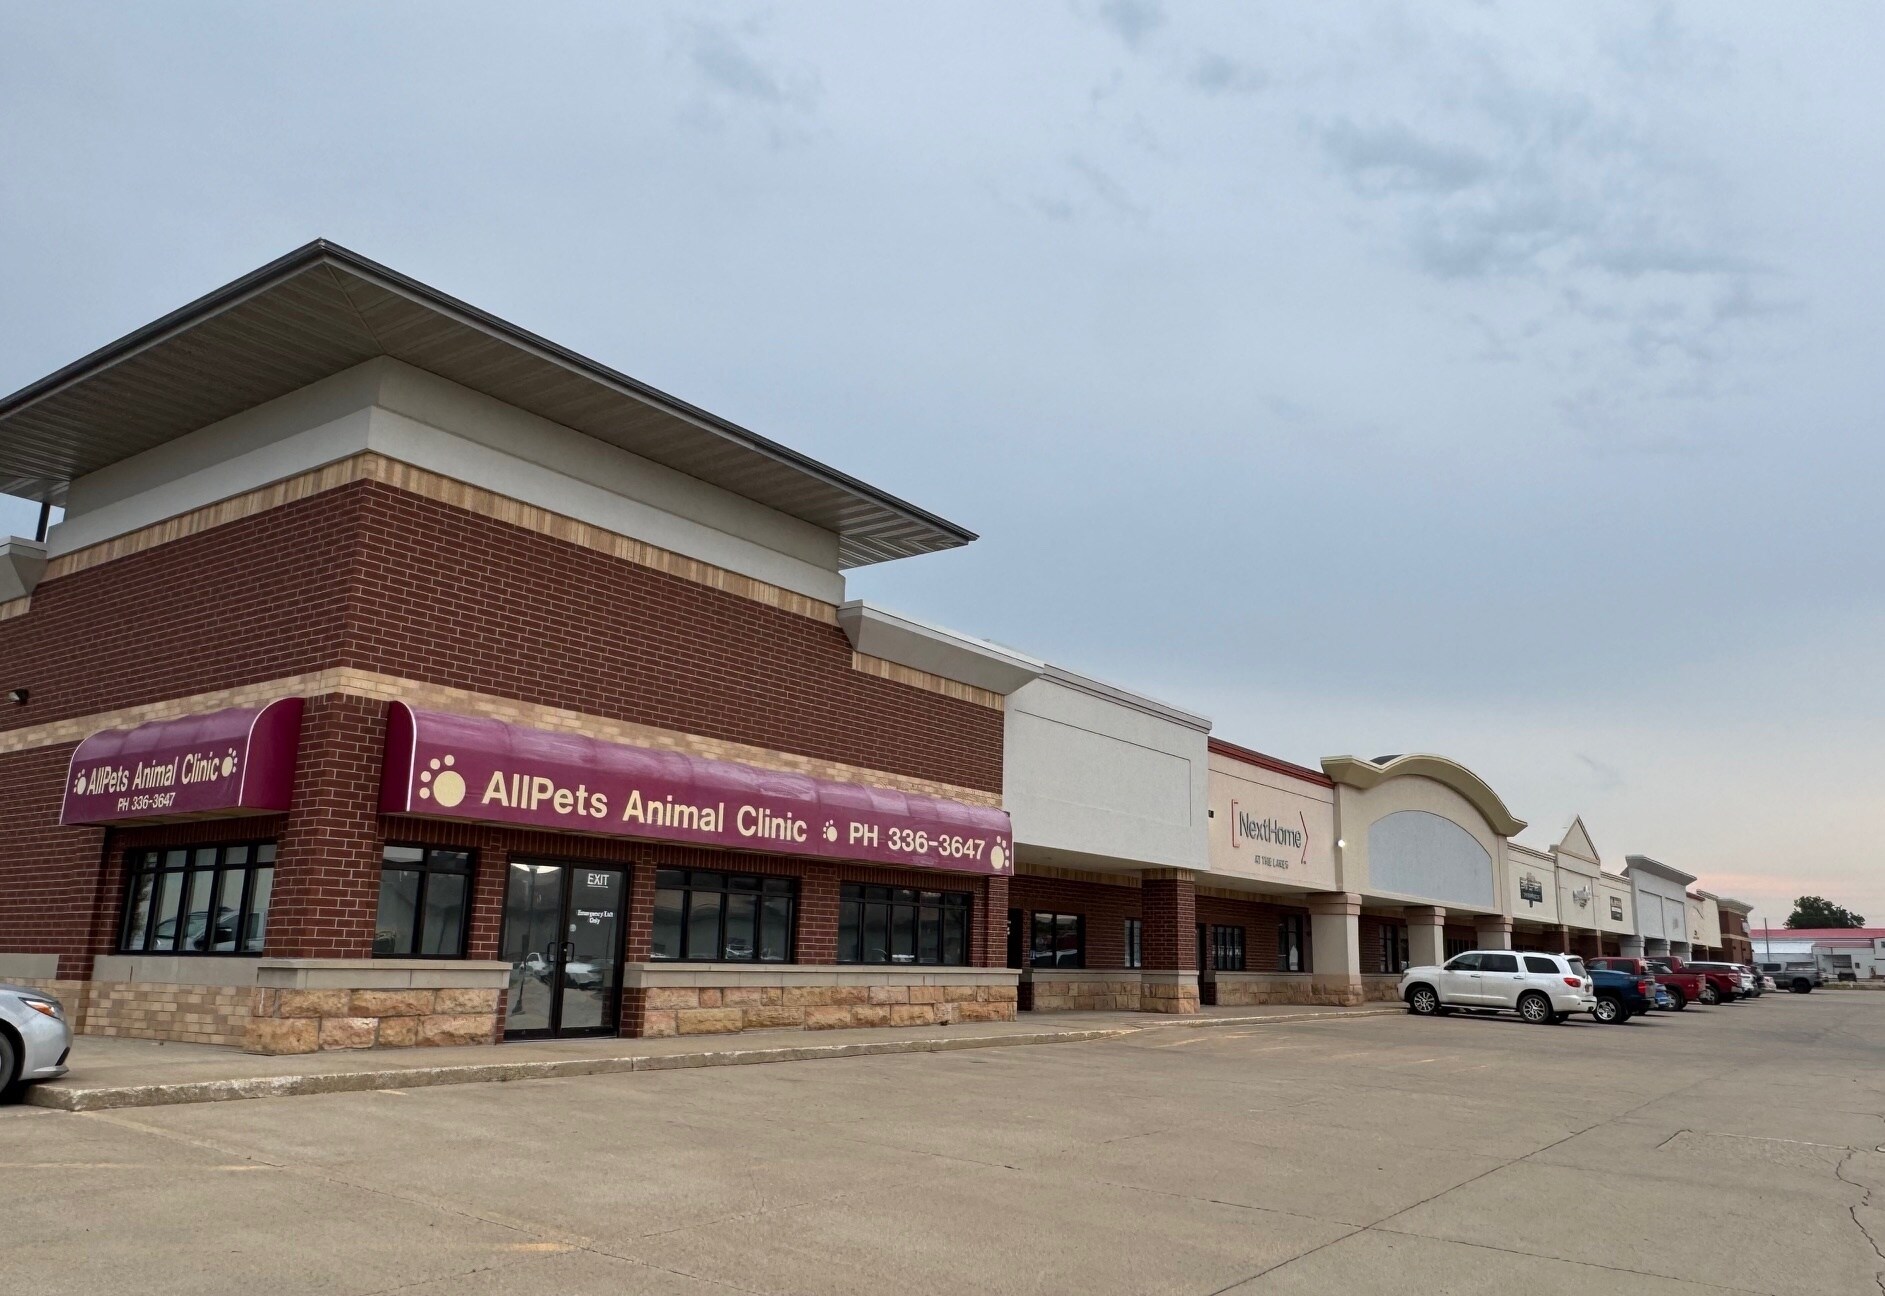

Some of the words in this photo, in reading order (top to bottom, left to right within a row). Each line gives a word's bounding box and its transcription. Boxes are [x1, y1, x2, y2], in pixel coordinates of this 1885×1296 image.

[87, 765, 130, 796] AllPets
[132, 756, 179, 791] Animal
[181, 751, 220, 785] Clinic
[117, 797, 129, 812] PH
[131, 792, 176, 811] 336-3647
[481, 770, 608, 818] AllPets
[622, 789, 725, 833] Animal
[736, 805, 808, 843] Clinic
[849, 822, 879, 848] PH
[887, 826, 986, 860] 336-3647
[1239, 810, 1302, 848] NextHome
[587, 873, 610, 886] EXIT
